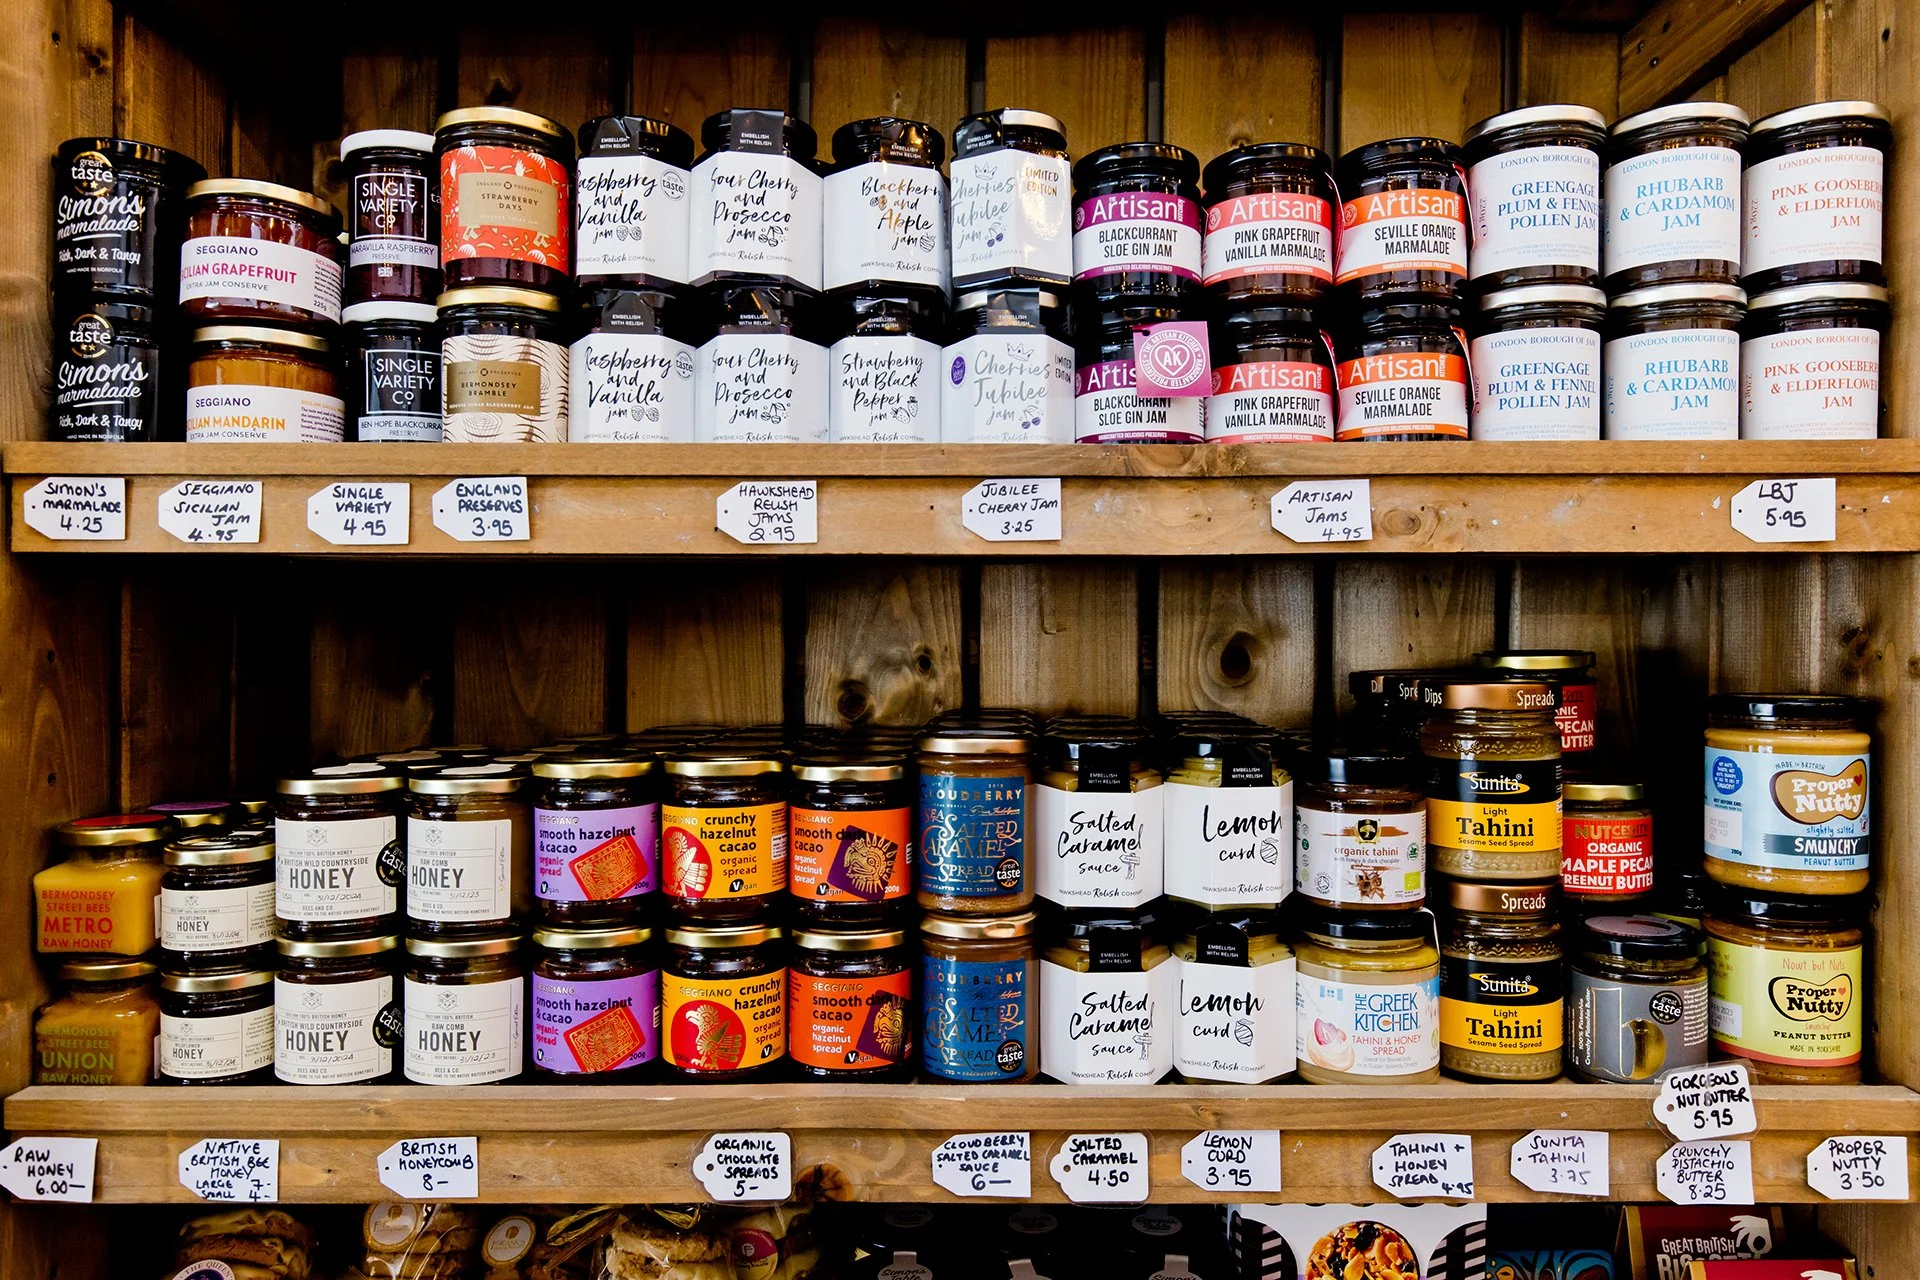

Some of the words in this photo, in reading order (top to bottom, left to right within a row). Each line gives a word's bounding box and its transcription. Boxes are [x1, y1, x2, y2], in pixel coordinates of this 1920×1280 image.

[1622, 159, 1659, 174] LONDON
[1661, 153, 1705, 163] BOROUGH
[71, 167, 113, 183] taste
[362, 182, 415, 198] SINGLE
[748, 169, 799, 199] Cherry
[1512, 181, 1596, 197] GREENGAGE
[1636, 177, 1724, 199] RHUBARB
[360, 200, 417, 213] VARIETY
[482, 192, 538, 206] STRAWBERRY
[57, 191, 145, 224] Simon's
[499, 202, 522, 212] DAYS
[713, 201, 792, 226] Prosecco
[1092, 194, 1177, 223] Artisan
[1634, 198, 1735, 216] CARDAMOM
[878, 211, 933, 235] Apple
[1099, 227, 1177, 243] BLACKCURRANT
[1235, 229, 1259, 245] PINK
[1262, 228, 1320, 244] GRAPEFRUIT
[1375, 224, 1419, 242] SEVILLE
[1421, 223, 1456, 240] ORANGE
[75, 247, 97, 260] Dark
[100, 248, 109, 259] &
[111, 248, 141, 265] Tangy
[196, 245, 258, 256] SEGGIANO
[387, 242, 435, 256] RASPBERRY
[1104, 243, 1129, 258] SLOE
[1132, 243, 1150, 256] GIN
[1153, 243, 1172, 257] JAM
[222, 280, 269, 291] CONSERVE
[584, 347, 672, 379] Raspberry
[842, 351, 924, 374] Strawberry
[975, 350, 1051, 380] Cherries
[1163, 350, 1181, 366] AK
[461, 381, 517, 389] BERMONDSEY
[874, 371, 919, 391] Black
[1488, 380, 1528, 395] PLUM
[1535, 379, 1545, 391] &
[1551, 378, 1596, 393] FENNEL
[588, 381, 664, 408] Vanilla
[853, 389, 903, 411] Pepper
[974, 378, 1048, 407] Jubilee
[214, 416, 285, 430] MANDARIN
[44, 482, 107, 497] SIMON'S
[178, 483, 254, 496] SEGGIANO
[332, 485, 384, 499] SINGLE
[456, 483, 522, 497] ENGLAND
[739, 485, 814, 499] HAWKSHEAD
[981, 483, 1039, 498] JUBILEE
[1288, 490, 1353, 504] ARTISAN
[1758, 482, 1798, 503] LBJ
[43, 500, 122, 513] MARMALADE
[174, 501, 240, 514] SICILIAN
[335, 501, 391, 514] VARIETY
[458, 499, 523, 513] PRESERVES
[978, 502, 1027, 514] CHERRY
[1031, 498, 1058, 510] JAM
[61, 516, 103, 532] 4.25
[212, 514, 250, 527] JAM
[748, 512, 793, 527] JAMS
[1766, 508, 1806, 528] 5.95
[343, 518, 386, 537] 4.95
[471, 516, 513, 537] 3.95
[749, 526, 795, 541] 2.95
[1001, 519, 1034, 535] 3.25
[1322, 527, 1363, 541] 4.95
[188, 528, 238, 541] 4.95
[1425, 687, 1443, 705] Dips
[1517, 690, 1555, 709] Spreads
[1470, 774, 1519, 792] Sunita
[1792, 778, 1854, 795] Proper
[1793, 793, 1862, 814] Nutty
[705, 813, 756, 826] crunchy
[1483, 807, 1507, 817] Light
[1069, 810, 1136, 835] Salted
[1203, 804, 1283, 843] Lemon
[1456, 817, 1534, 838] Tahini
[700, 826, 756, 840] hazelnut
[1807, 824, 1834, 838] slightly
[1057, 823, 1144, 859] Caramel
[1458, 838, 1485, 847] Sesame
[1488, 838, 1507, 847] Seed
[1509, 839, 1534, 848] Spread
[1587, 841, 1642, 854] ORGANIC
[1794, 837, 1858, 855] SMUNCHY
[1334, 847, 1369, 856] organic
[1373, 847, 1398, 856] tahini
[321, 857, 369, 866] COUNTRYSIDE
[1804, 858, 1832, 866] PEANUT
[1834, 857, 1855, 866] BUTTER
[289, 867, 355, 889] HONEY
[42, 889, 115, 901] BERMONDSEY
[44, 916, 113, 935] METRO
[177, 920, 209, 932] HONEY
[43, 938, 69, 948] RAW
[74, 938, 113, 949] HONEY
[1782, 958, 1807, 970] Nowt
[1812, 959, 1825, 971] but
[1829, 959, 1846, 970] Nuts
[812, 983, 864, 992] SEGGIANO
[812, 994, 863, 1007] smooth
[1355, 993, 1367, 1011] THE
[1368, 992, 1418, 1012] GREEK
[812, 1008, 853, 1021] cacao
[1652, 1000, 1681, 1017] taste
[812, 1024, 844, 1035] organic
[1354, 1012, 1419, 1032] KITCHEN
[1670, 1070, 1740, 1092] GORGEOUS
[1676, 1093, 1700, 1109] NUT
[1704, 1087, 1749, 1107] BUTTER
[1693, 1109, 1733, 1129] 5.95
[714, 1138, 776, 1151] ORGANIC
[1069, 1138, 1123, 1152] SALTED
[1204, 1131, 1252, 1149] LEMON
[1530, 1135, 1585, 1150] SUNITA
[14, 1147, 51, 1163] RAW
[204, 1141, 261, 1155] NATIVE
[401, 1141, 456, 1156] BRITISH
[937, 1150, 978, 1162] SALTED
[982, 1149, 1030, 1161] CARAMEL
[1389, 1142, 1445, 1156] TAHINI
[1672, 1143, 1731, 1158] CRUNCHY
[1828, 1139, 1887, 1158] PROPER
[190, 1155, 240, 1167] BRITISH
[247, 1158, 270, 1169] BEE
[399, 1154, 474, 1170] HONEYCOMB
[717, 1153, 780, 1165] CHOCOLATE
[1072, 1152, 1138, 1166] CARAMEL
[1208, 1149, 1246, 1163] CURD
[1528, 1153, 1586, 1165] TAHINI
[27, 1164, 74, 1178] HONEY
[959, 1162, 999, 1173] SAUCE
[1395, 1159, 1447, 1172] HONEY
[1672, 1158, 1735, 1170] PISTACHIO
[1832, 1157, 1882, 1172] NUTTY
[210, 1166, 253, 1179] HONEY
[724, 1166, 778, 1179] SPREADS
[1088, 1169, 1129, 1187] 4.50
[1206, 1166, 1252, 1186] 3.95
[1388, 1173, 1438, 1187] SPREAD
[1550, 1168, 1592, 1186] 3.75
[1677, 1170, 1724, 1184] BUTTER
[195, 1179, 233, 1189] LARGE
[1442, 1181, 1473, 1195] 4.95
[1840, 1172, 1884, 1190] 3.50
[201, 1189, 235, 1200] SMALL
[1688, 1183, 1726, 1200] 8.25
[1661, 1238, 1694, 1255] GREAT
[1695, 1237, 1736, 1255] BRITISH
